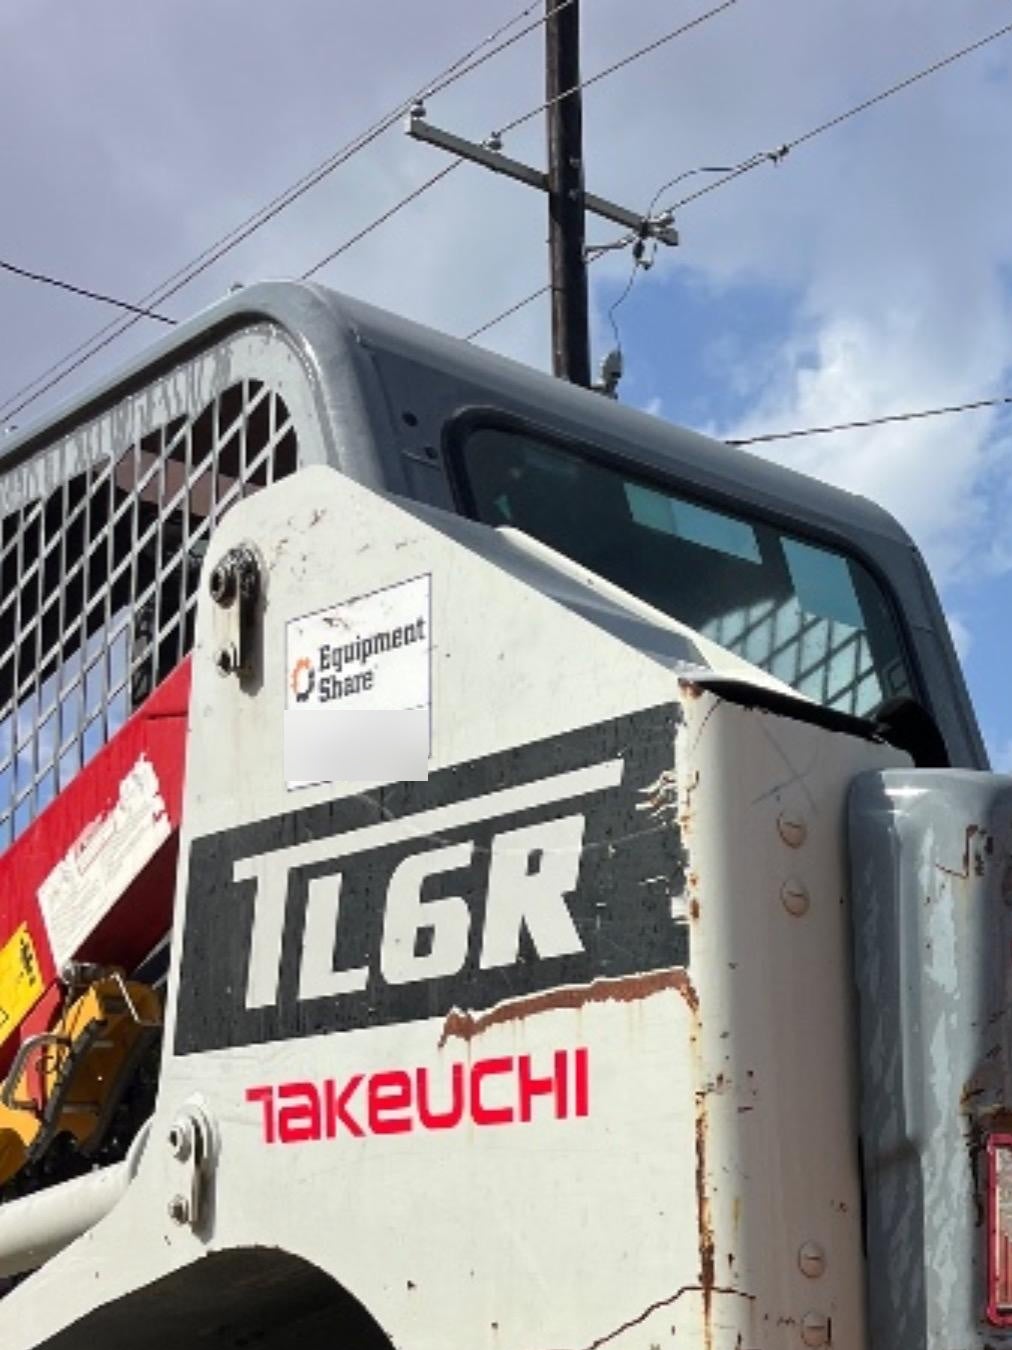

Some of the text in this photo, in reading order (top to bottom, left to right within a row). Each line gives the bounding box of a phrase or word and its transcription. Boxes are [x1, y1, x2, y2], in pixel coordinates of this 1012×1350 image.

[318, 615, 426, 672] Equipment
[318, 669, 374, 703] Share
[232, 758, 625, 1010] TL6R
